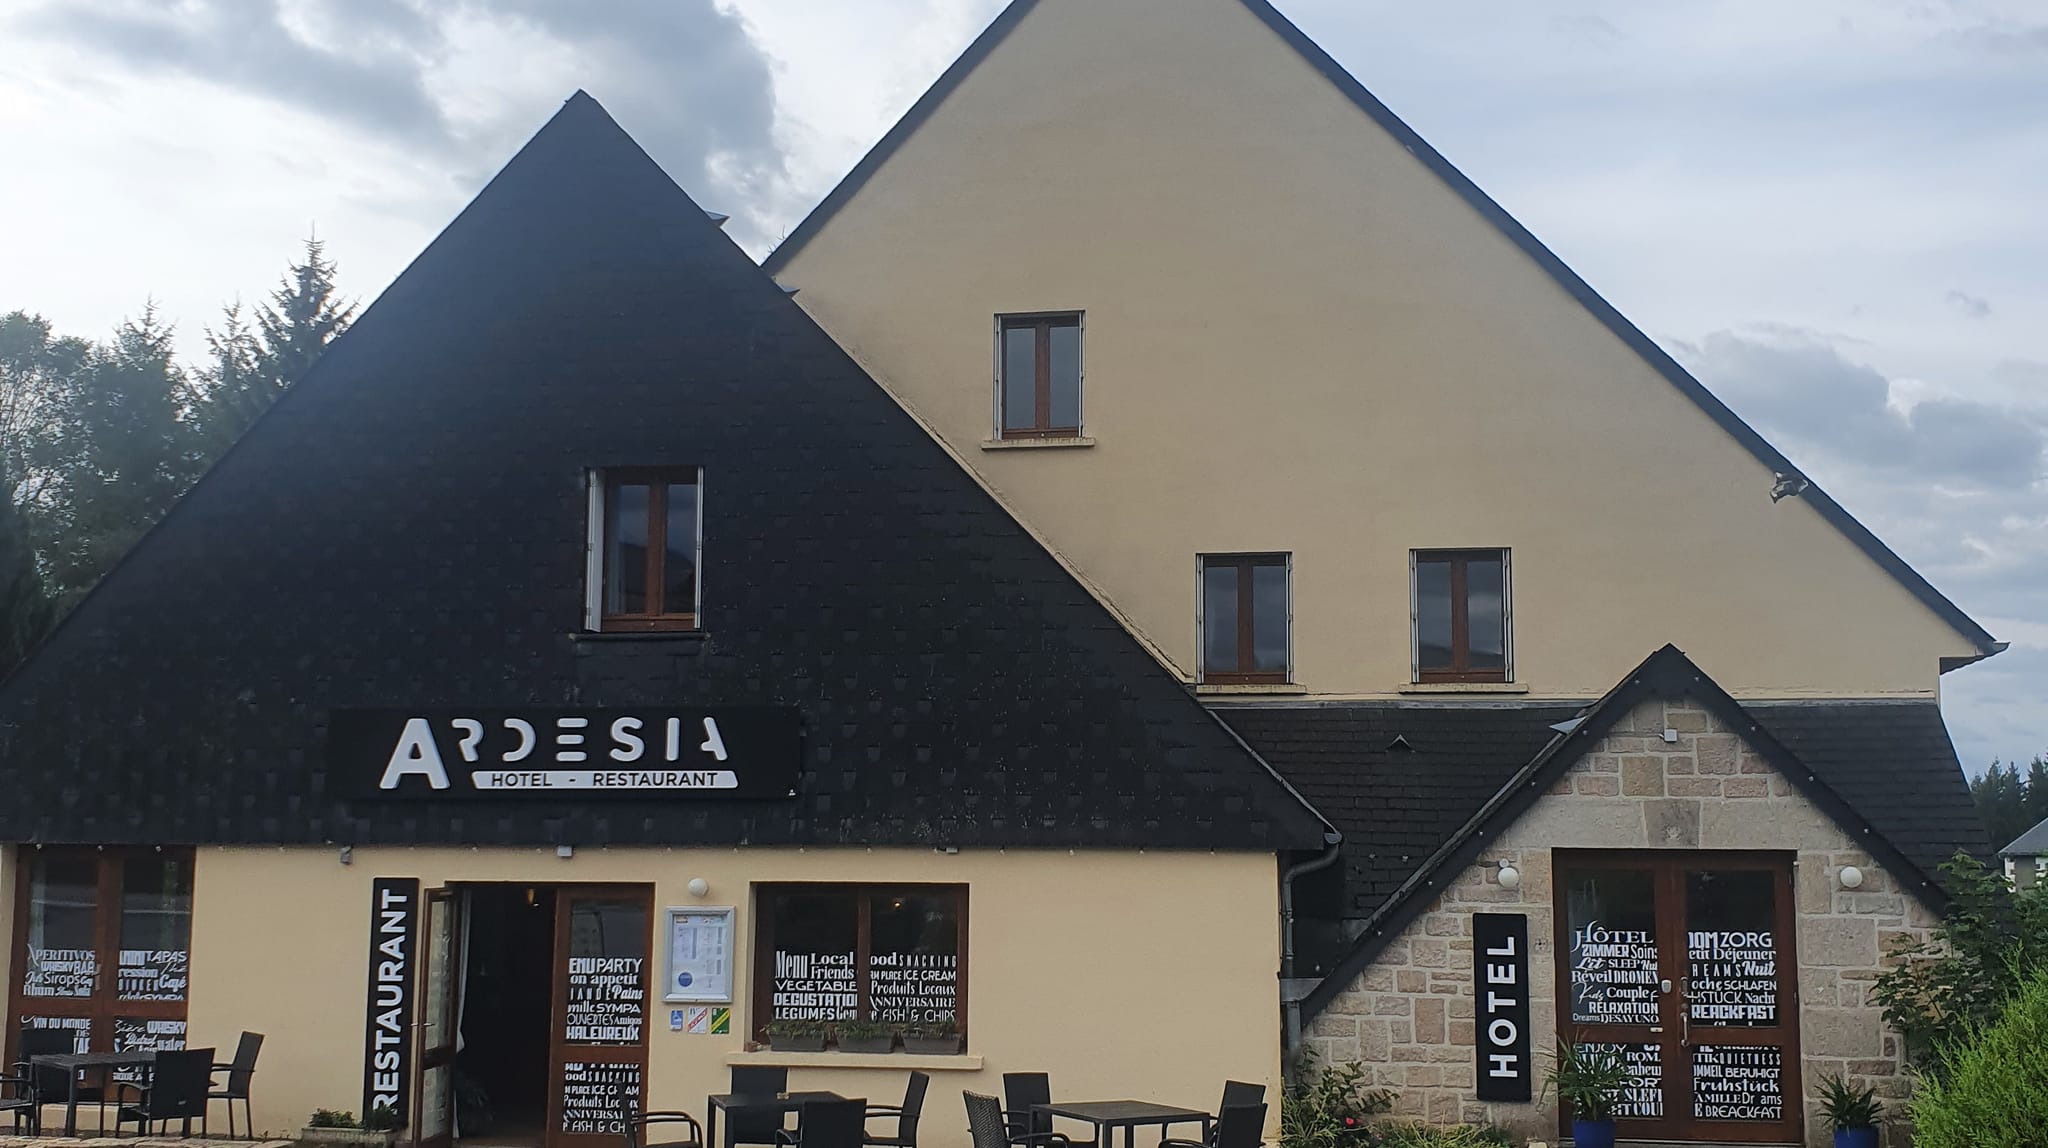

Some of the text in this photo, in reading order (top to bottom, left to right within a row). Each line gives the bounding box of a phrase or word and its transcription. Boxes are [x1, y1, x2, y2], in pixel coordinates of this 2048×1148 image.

[379, 716, 728, 789] ARDESIA
[491, 773, 552, 787] HOTEL
[593, 772, 718, 787] RESTAURANT
[1720, 932, 1772, 948] ZORG
[1582, 944, 1630, 958] ZIMMER
[1713, 947, 1776, 964] Déjeuner
[596, 958, 642, 973] PARTY
[775, 951, 854, 979] Menu Local
[870, 952, 957, 968] ood SNACKING
[811, 965, 855, 980] Friends
[881, 971, 902, 980] PLACE
[903, 969, 919, 981] ICE
[921, 970, 956, 981] CREAM
[1741, 960, 1776, 976] Nuit
[44, 972, 80, 987] Sirops
[570, 975, 587, 984] on
[775, 980, 857, 991] VEGETABLE
[1724, 980, 1777, 991] SCHLAFEN
[612, 985, 643, 999] Pains
[871, 981, 956, 995] Produits Locaux
[1606, 986, 1649, 1002] Couple
[373, 889, 407, 1115] RESTAURANT
[595, 1003, 641, 1013] SYMPA
[1487, 937, 1518, 1077] HOTEL
[775, 1008, 835, 1020] LEGUMES
[882, 1008, 906, 1021] FISH
[924, 1009, 956, 1022] CHIPS
[1572, 1013, 1660, 1023] Dreams DESAYUNO
[1725, 1067, 1781, 1078] BERUHIGT
[1705, 1105, 1782, 1119] BREACKFAST
[572, 1121, 593, 1132] FISH
